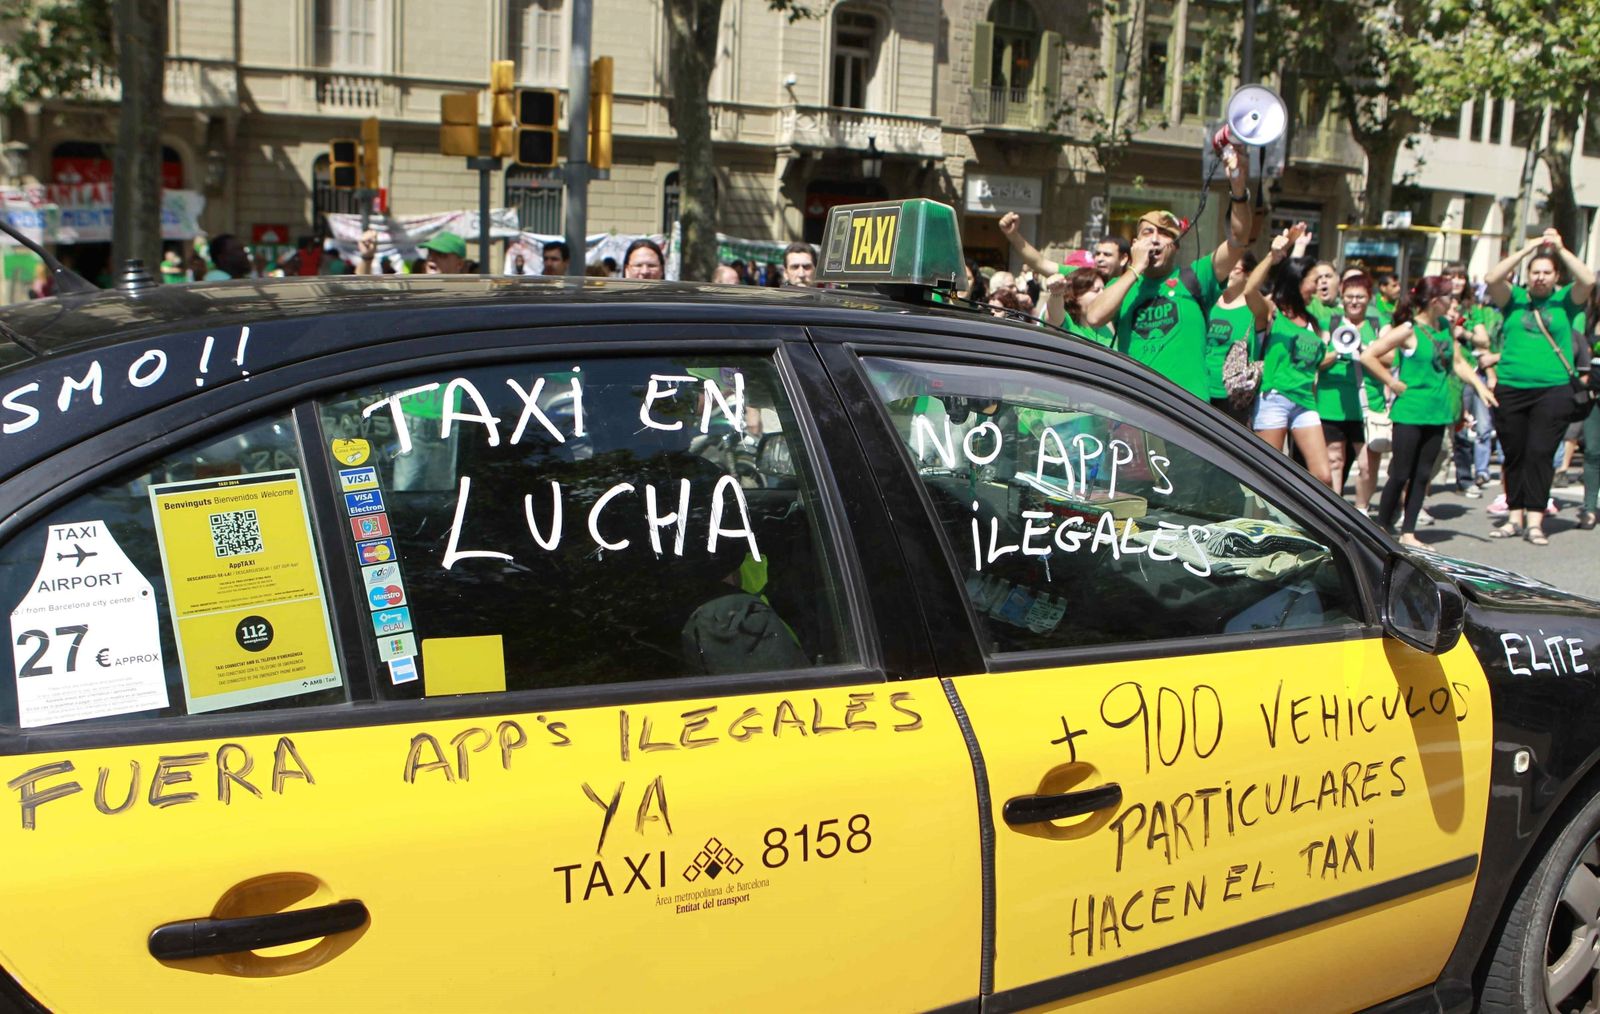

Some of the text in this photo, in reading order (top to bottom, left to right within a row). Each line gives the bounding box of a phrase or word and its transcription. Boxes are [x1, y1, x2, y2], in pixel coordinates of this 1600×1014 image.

[851, 215, 896, 264] TAXI
[1137, 303, 1172, 323] STOP
[640, 372, 745, 433] EN
[915, 414, 1003, 468] NO
[346, 474, 370, 484] VISA
[164, 488, 294, 510] Benvinguts Bienvenidos Welcome
[354, 493, 373, 502] VISA
[350, 504, 382, 514] Electron
[54, 526, 97, 541] TAXI
[441, 475, 761, 570] LUCHA
[229, 560, 256, 569] AppTAXI
[38, 572, 123, 593] AIRPORT
[26, 604, 46, 614] from
[48, 600, 91, 612] Barcelona
[92, 598, 108, 609] city
[110, 596, 136, 605] center
[373, 591, 400, 600] Maestro
[241, 624, 267, 640] 112
[382, 622, 404, 632] CLAU
[16, 624, 89, 678] 27
[114, 652, 160, 667] APPROX
[1100, 681, 1223, 773] 900
[7, 736, 316, 830] FUERA
[619, 692, 923, 762] ILEGALES
[581, 775, 673, 855] YA
[553, 813, 872, 904] TAXI 8158
[674, 886, 723, 904] metropolitana
[726, 883, 734, 893] de
[736, 878, 770, 892] Barcelona
[676, 893, 750, 915] Entitat del transport
[1069, 874, 1207, 957] HACEN
[1223, 861, 1275, 902] EL
